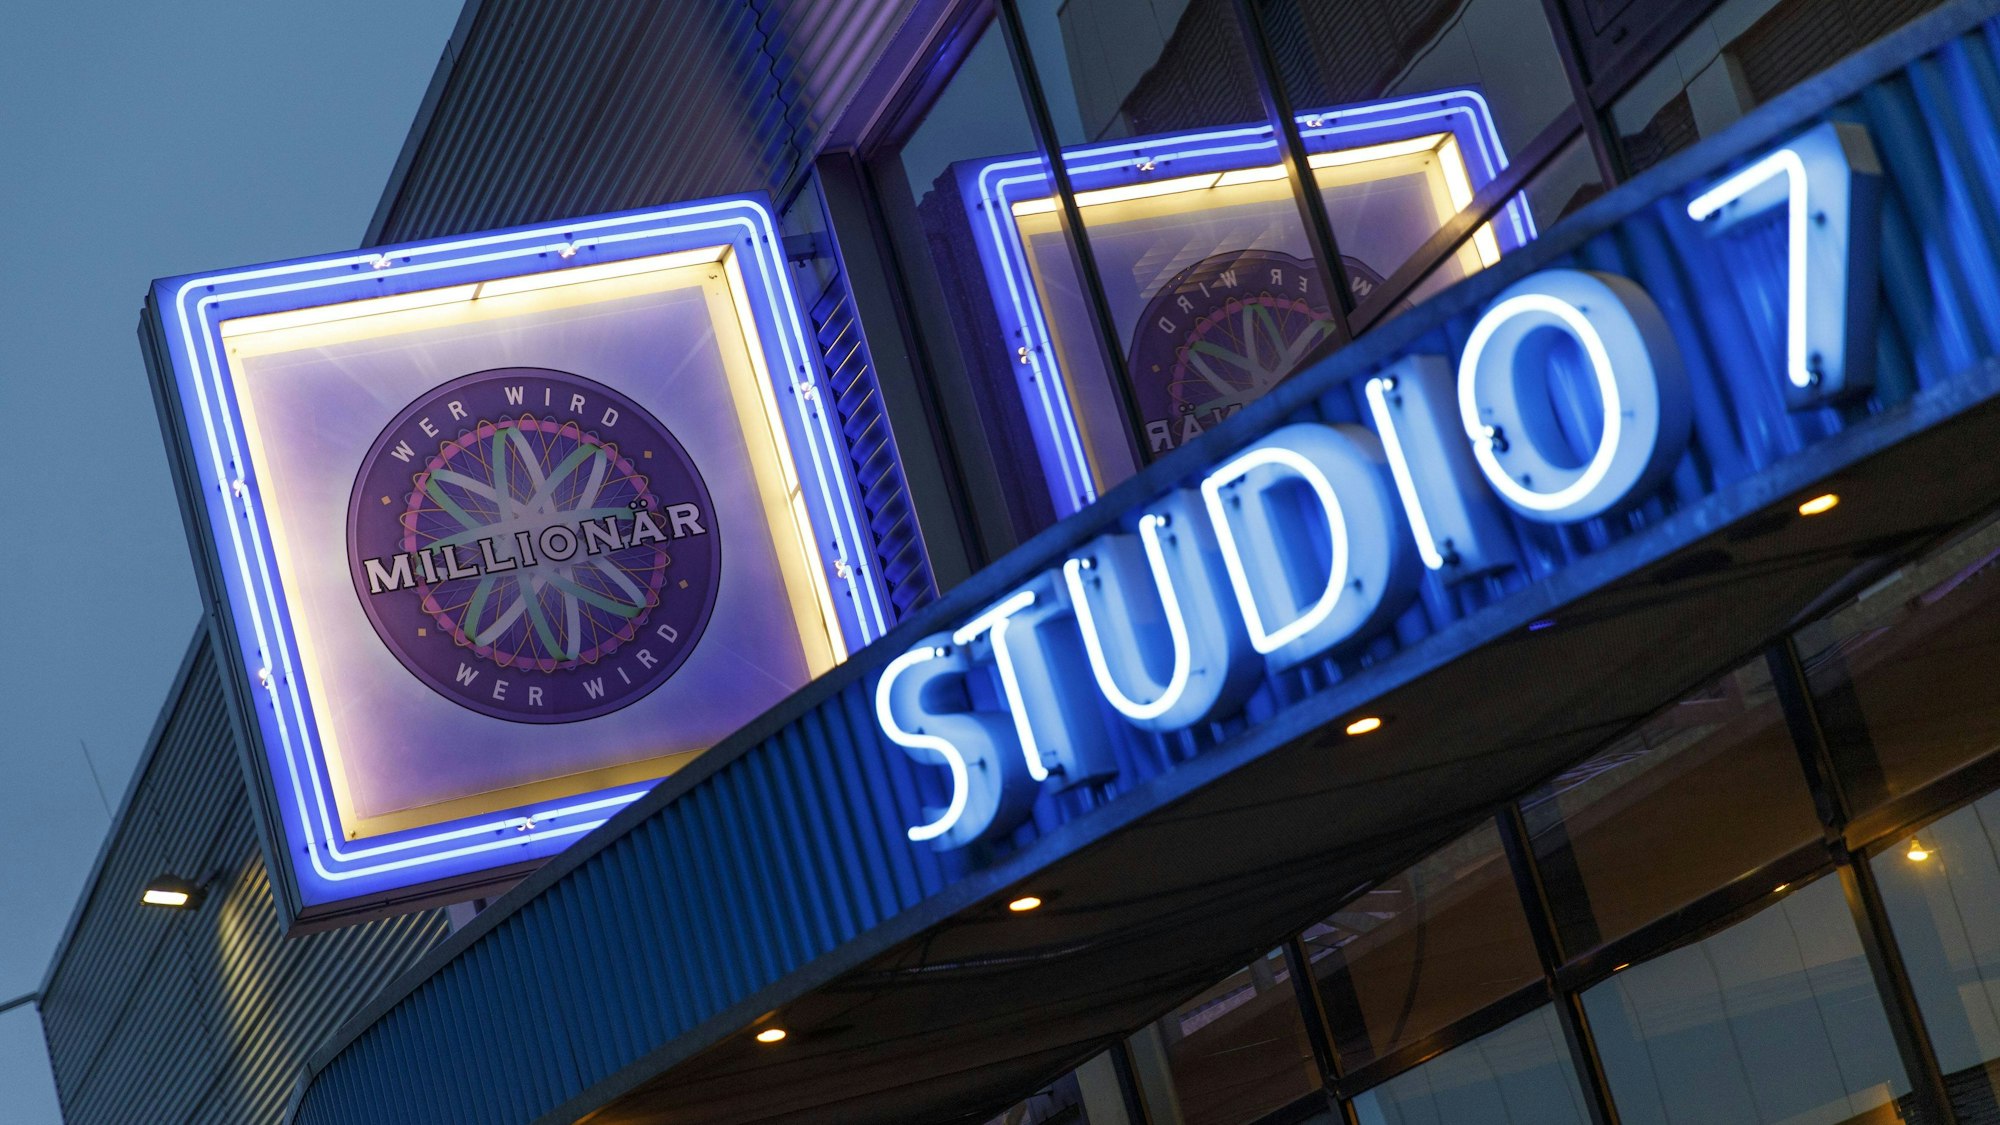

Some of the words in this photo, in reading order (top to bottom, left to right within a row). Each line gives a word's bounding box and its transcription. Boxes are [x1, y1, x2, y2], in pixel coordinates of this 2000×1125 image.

[391, 400, 468, 463] WER
[504, 386, 619, 428] WIRD
[875, 270, 1660, 846] STUDIO
[1686, 124, 1858, 394] 7
[364, 500, 706, 595] MILLIONÄR
[455, 663, 544, 706] WER
[582, 623, 679, 700] WIRD
